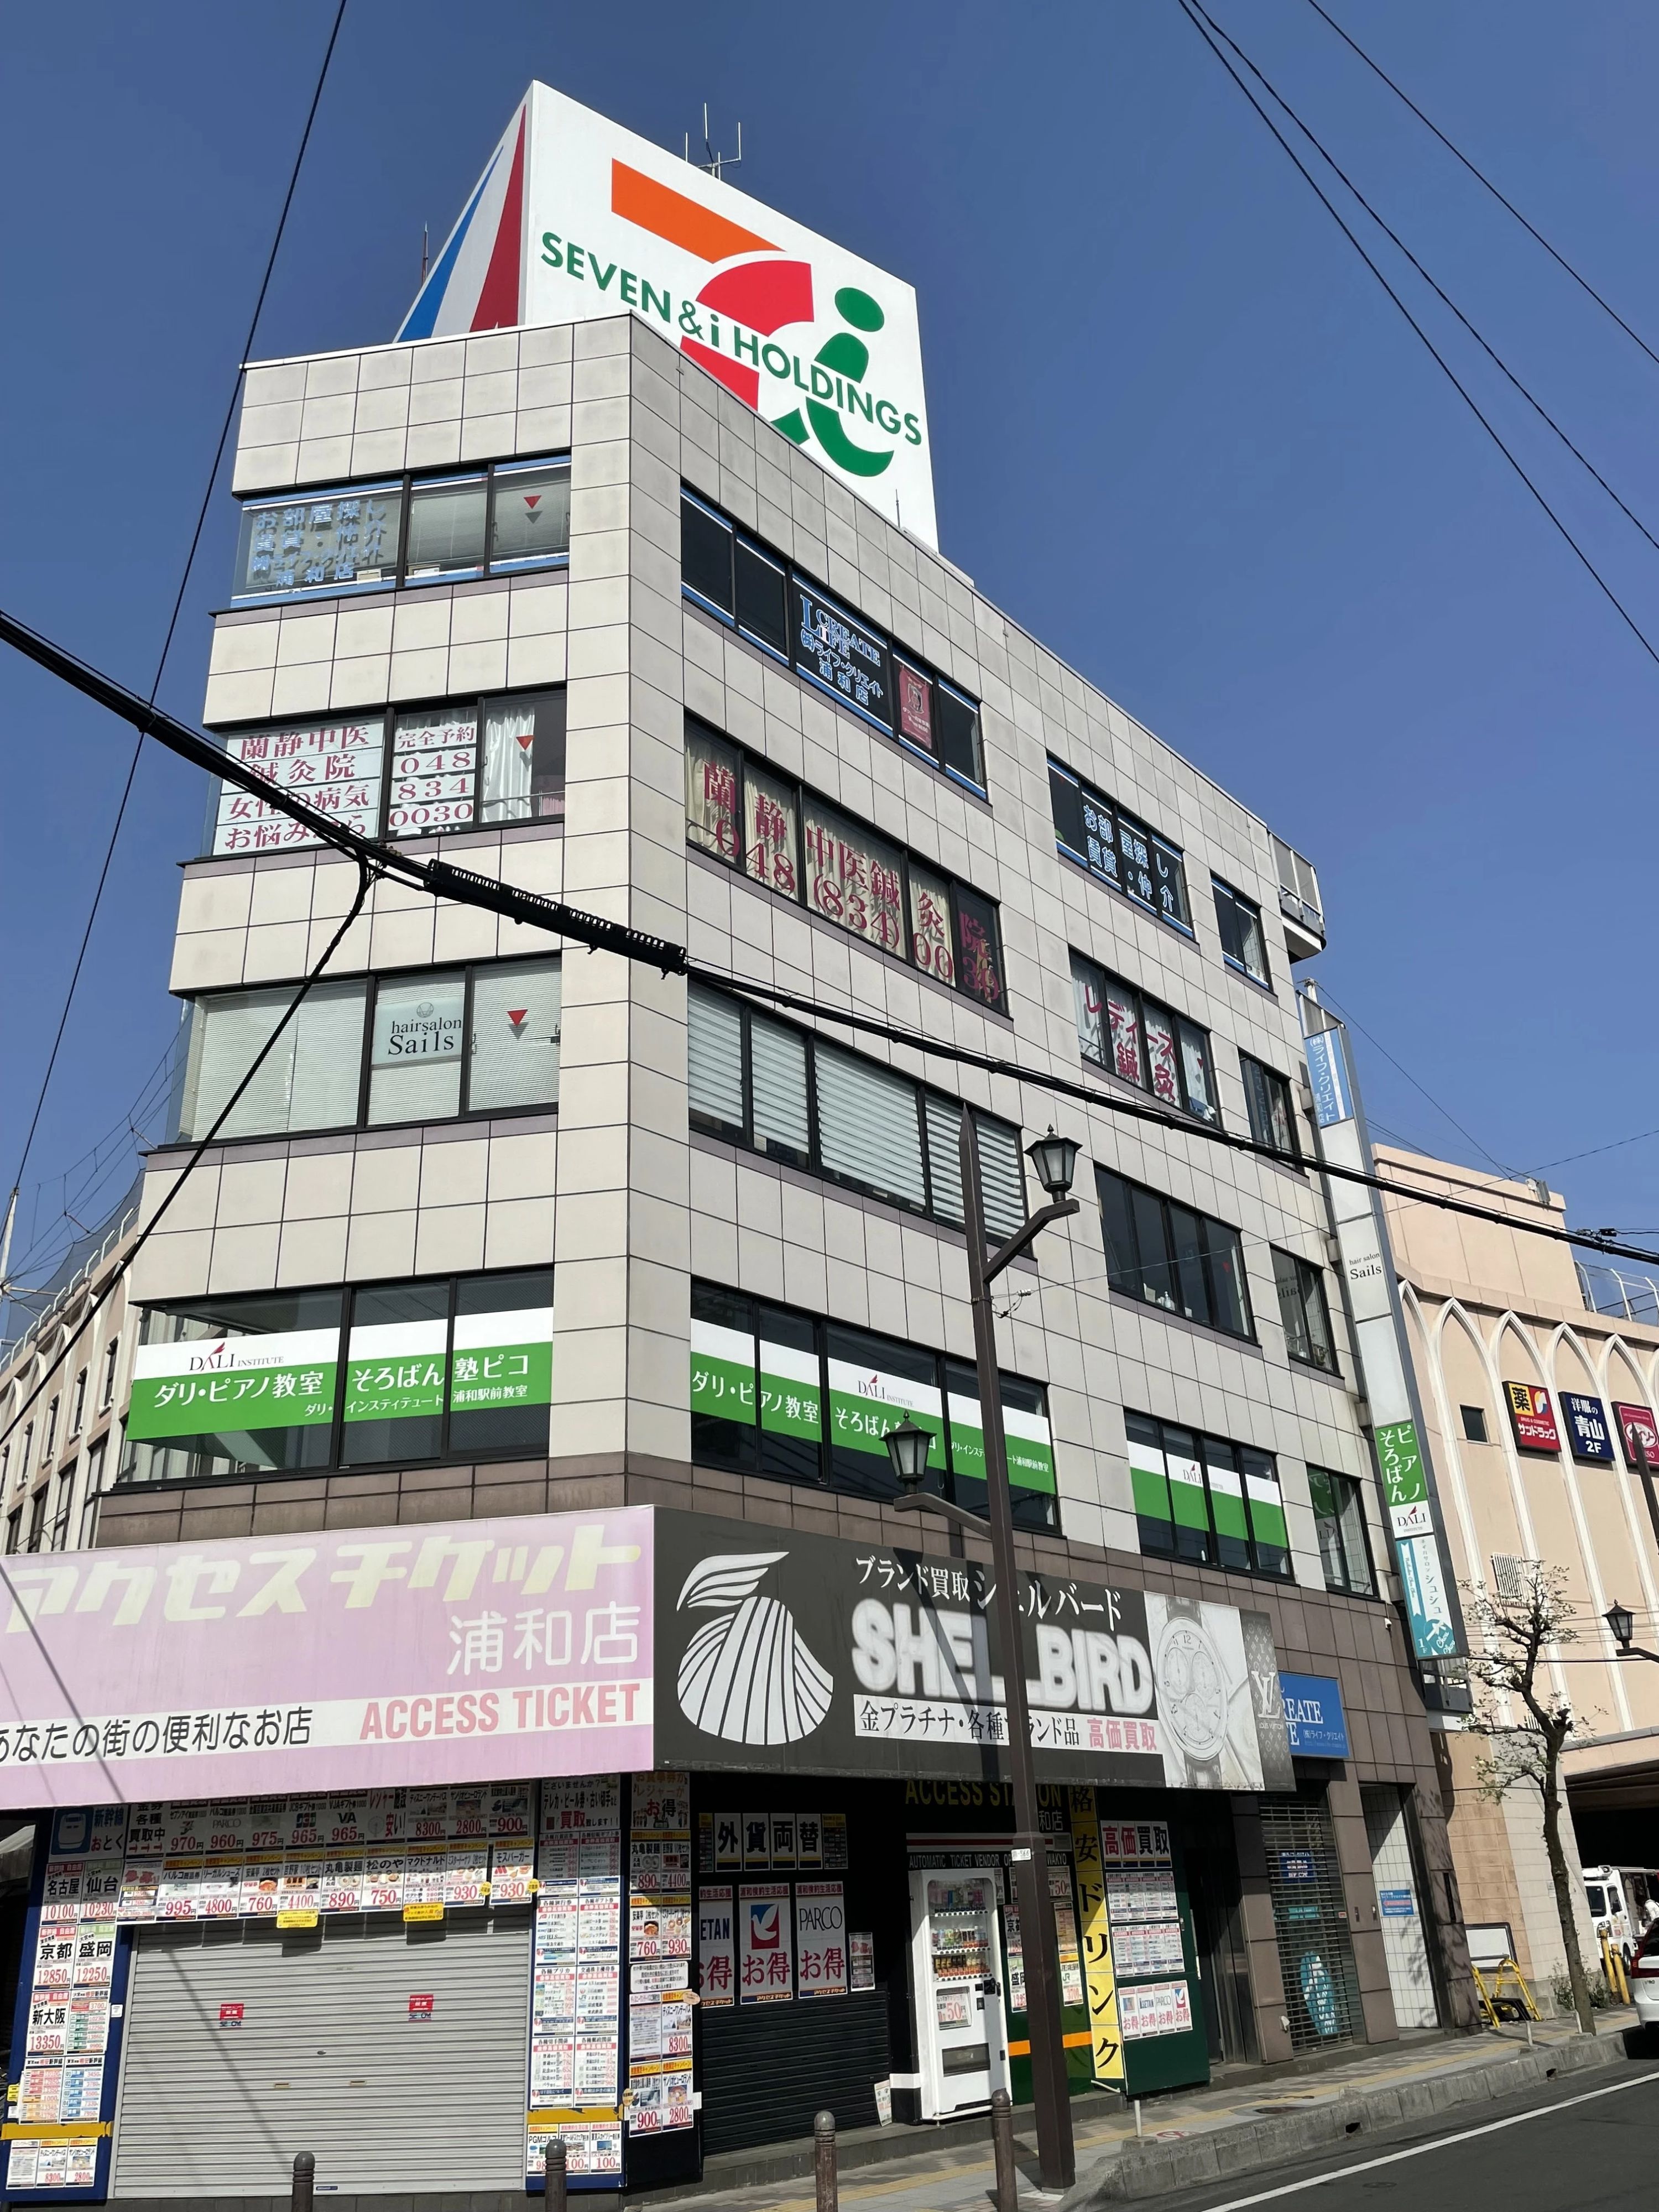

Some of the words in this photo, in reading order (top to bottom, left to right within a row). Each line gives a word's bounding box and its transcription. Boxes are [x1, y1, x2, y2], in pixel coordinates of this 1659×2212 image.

[541, 232, 670, 324] SEVEN
[735, 325, 921, 445] HOLDINGS
[800, 594, 850, 659] LIFE
[816, 609, 880, 666] CREATE
[819, 658, 868, 706] 浦和店
[241, 723, 369, 761] 蘭静中医
[398, 726, 475, 748] 完全予約
[401, 752, 471, 774] 048
[399, 778, 469, 800] 834
[389, 803, 473, 827] 0030
[225, 815, 366, 850] お悩みら
[1083, 805, 1168, 878] お部屋探し
[1087, 836, 1173, 912] 賃貸・仲介
[388, 1031, 454, 1055] Sails
[1349, 1257, 1361, 1265] hair
[1363, 1253, 1380, 1261] salon
[1350, 1265, 1382, 1280] Sails
[189, 1342, 235, 1372] DALI
[237, 1355, 284, 1368] INSTITUTE
[154, 1370, 324, 1408] ダリ・ピアノ教室
[352, 1354, 529, 1391] そろばん塾ピコ
[692, 1370, 818, 1424] ダリ・ピアノ教室
[858, 1374, 885, 1399] DALI
[887, 1395, 914, 1407] INSTITUTE
[1512, 1386, 1530, 1411] 薬
[1571, 1397, 1598, 1415] 洋服の
[1518, 1422, 1557, 1440] サンドラッグ
[1574, 1415, 1605, 1441] 青山
[1585, 1441, 1601, 1453] 2F
[1380, 1430, 1407, 1503] そろばん
[1397, 1426, 1421, 1500] ピアノ
[1397, 1505, 1426, 1527] DALI
[6, 1524, 641, 1634] アクセスチケット
[447, 1601, 641, 1675] 浦和店
[359, 1692, 499, 1740] ACCESS
[512, 1683, 640, 1729] TICKET
[1087, 1718, 1157, 1751] 高価買取
[647, 1799, 675, 1817] お得
[136, 1813, 163, 1825] 各種
[213, 1818, 241, 1828] PARCO
[457, 1819, 487, 1834] 2800円
[498, 1818, 528, 1832] 900円
[1039, 1809, 1063, 1831] 和店
[129, 1827, 165, 1843] 買取中
[291, 1829, 324, 1844] 965円
[332, 1826, 364, 1841] 965円
[415, 1822, 446, 1836] 8300円
[718, 1821, 818, 1854] 外貨両替
[91, 1834, 123, 1851] おとく
[171, 1836, 204, 1851] 970円
[211, 1834, 243, 1849] 960円
[252, 1832, 284, 1845] 975円
[1103, 1825, 1169, 1855] 高価買取
[367, 1859, 404, 1870] 松のや
[407, 1856, 445, 1866] マクドナルド
[497, 1853, 530, 1863] モスバーガー
[909, 1854, 946, 1868] AUTOMATIC
[951, 1854, 972, 1867] TICKET
[975, 1854, 1000, 1866] VENDOR
[47, 1879, 80, 1896] 名古屋
[86, 1876, 118, 1893] 仙台
[639, 1874, 660, 1888] 890円
[668, 1874, 690, 1887] 4400円
[249, 1897, 277, 1912] 760円
[288, 1895, 319, 1908] 4400円
[329, 1892, 359, 1907] 890円
[371, 1888, 401, 1905] 750円
[44, 1905, 78, 1920] 10100円
[165, 1901, 196, 1915] 995円
[205, 1899, 237, 1914] 4800円
[799, 1906, 842, 1931] PARCO
[1071, 1786, 1118, 2068] 格安ドリンク
[40, 1943, 73, 1960] 京都
[79, 1940, 113, 1958] 盛岡
[637, 1941, 660, 1955] 760円
[668, 1938, 691, 1954] 930円
[742, 1951, 790, 1986] お得
[800, 1947, 844, 1980] お得
[38, 1969, 70, 1984] 12850円
[77, 1967, 110, 1982] 12250円
[33, 2007, 66, 2026] 新大阪
[1123, 2016, 1139, 2030] お得
[1141, 2013, 1156, 2027] お得
[1159, 2011, 1174, 2025] お得
[1176, 2008, 1190, 2022] お得
[30, 2034, 64, 2051] 13350円
[669, 2036, 691, 2052] 8300円
[638, 2111, 660, 2128] 900円
[670, 2106, 692, 2124] 2800円
[597, 2157, 620, 2168] 100円
